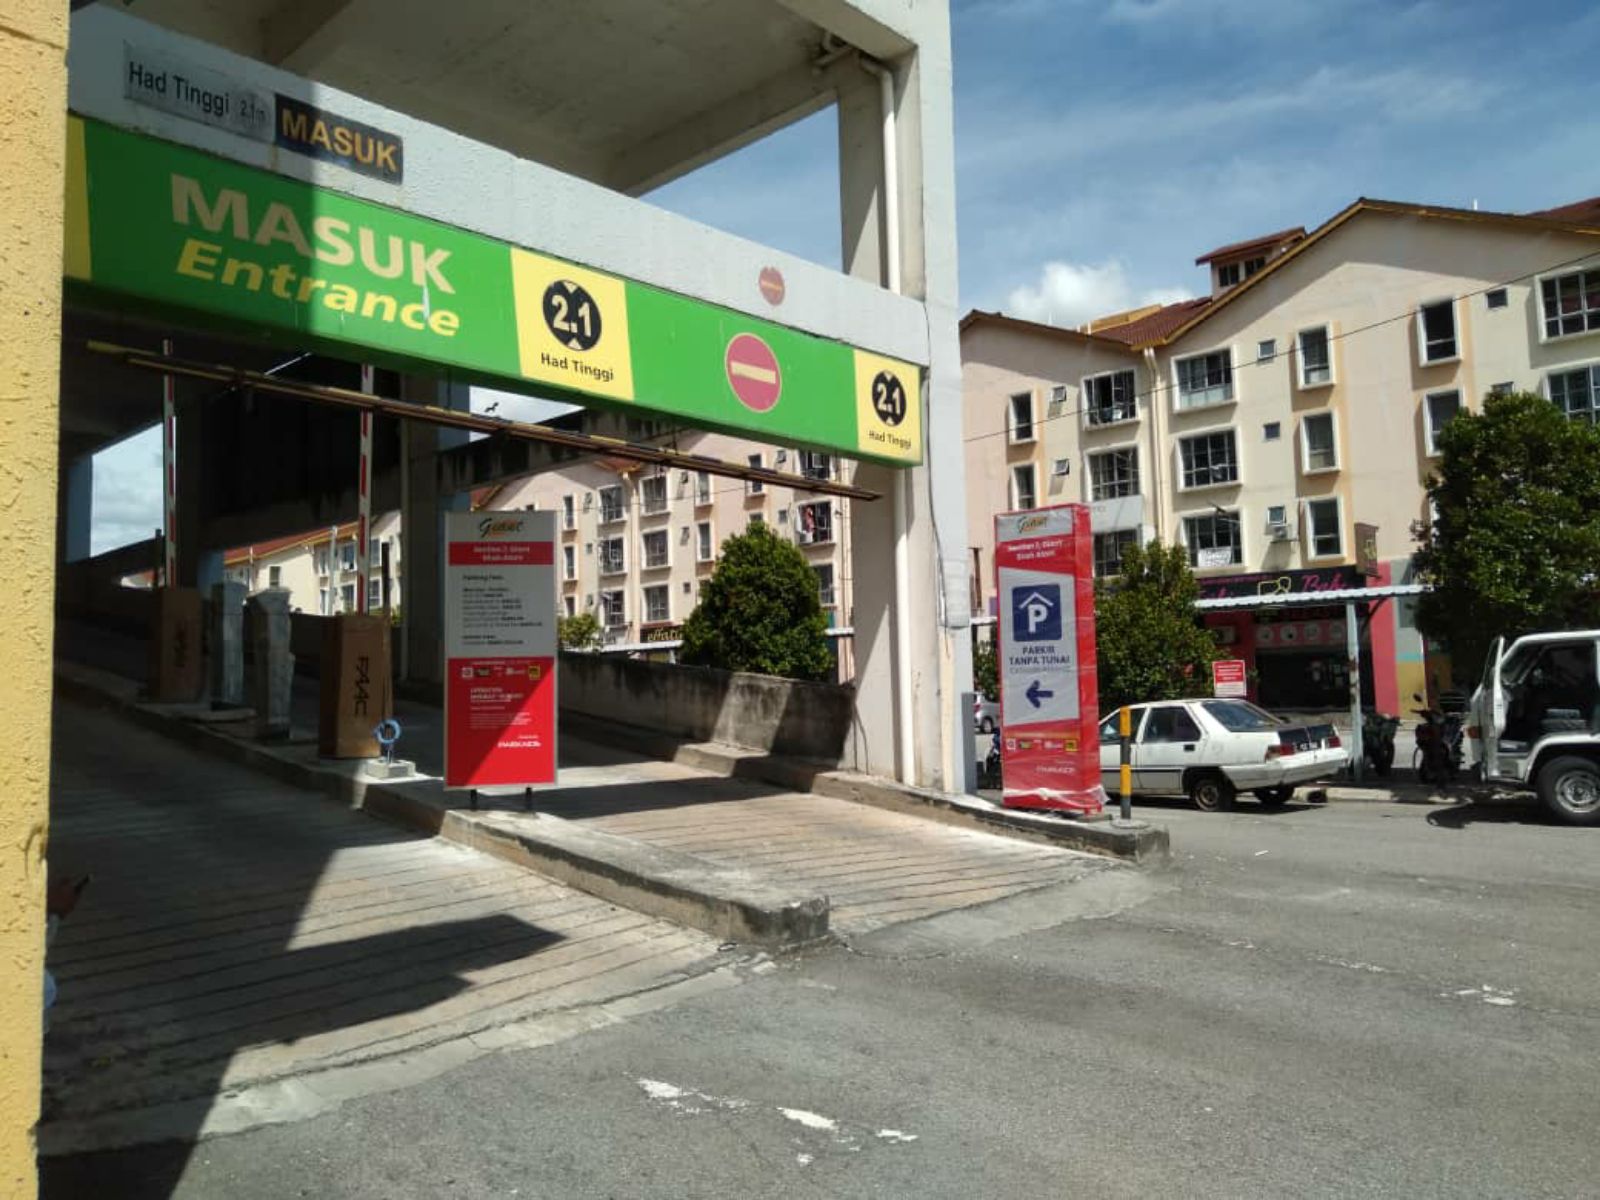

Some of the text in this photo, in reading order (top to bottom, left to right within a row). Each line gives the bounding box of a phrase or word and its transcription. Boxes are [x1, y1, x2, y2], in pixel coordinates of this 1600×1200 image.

[128, 61, 167, 93] Had
[172, 75, 230, 116] Tinggi
[280, 108, 398, 173] MASUK
[170, 173, 456, 294] MASUK
[176, 238, 461, 338] Entrance
[551, 294, 592, 338] 2.1
[541, 352, 614, 382] Had Tinggi
[868, 430, 911, 450] Had Tinggi
